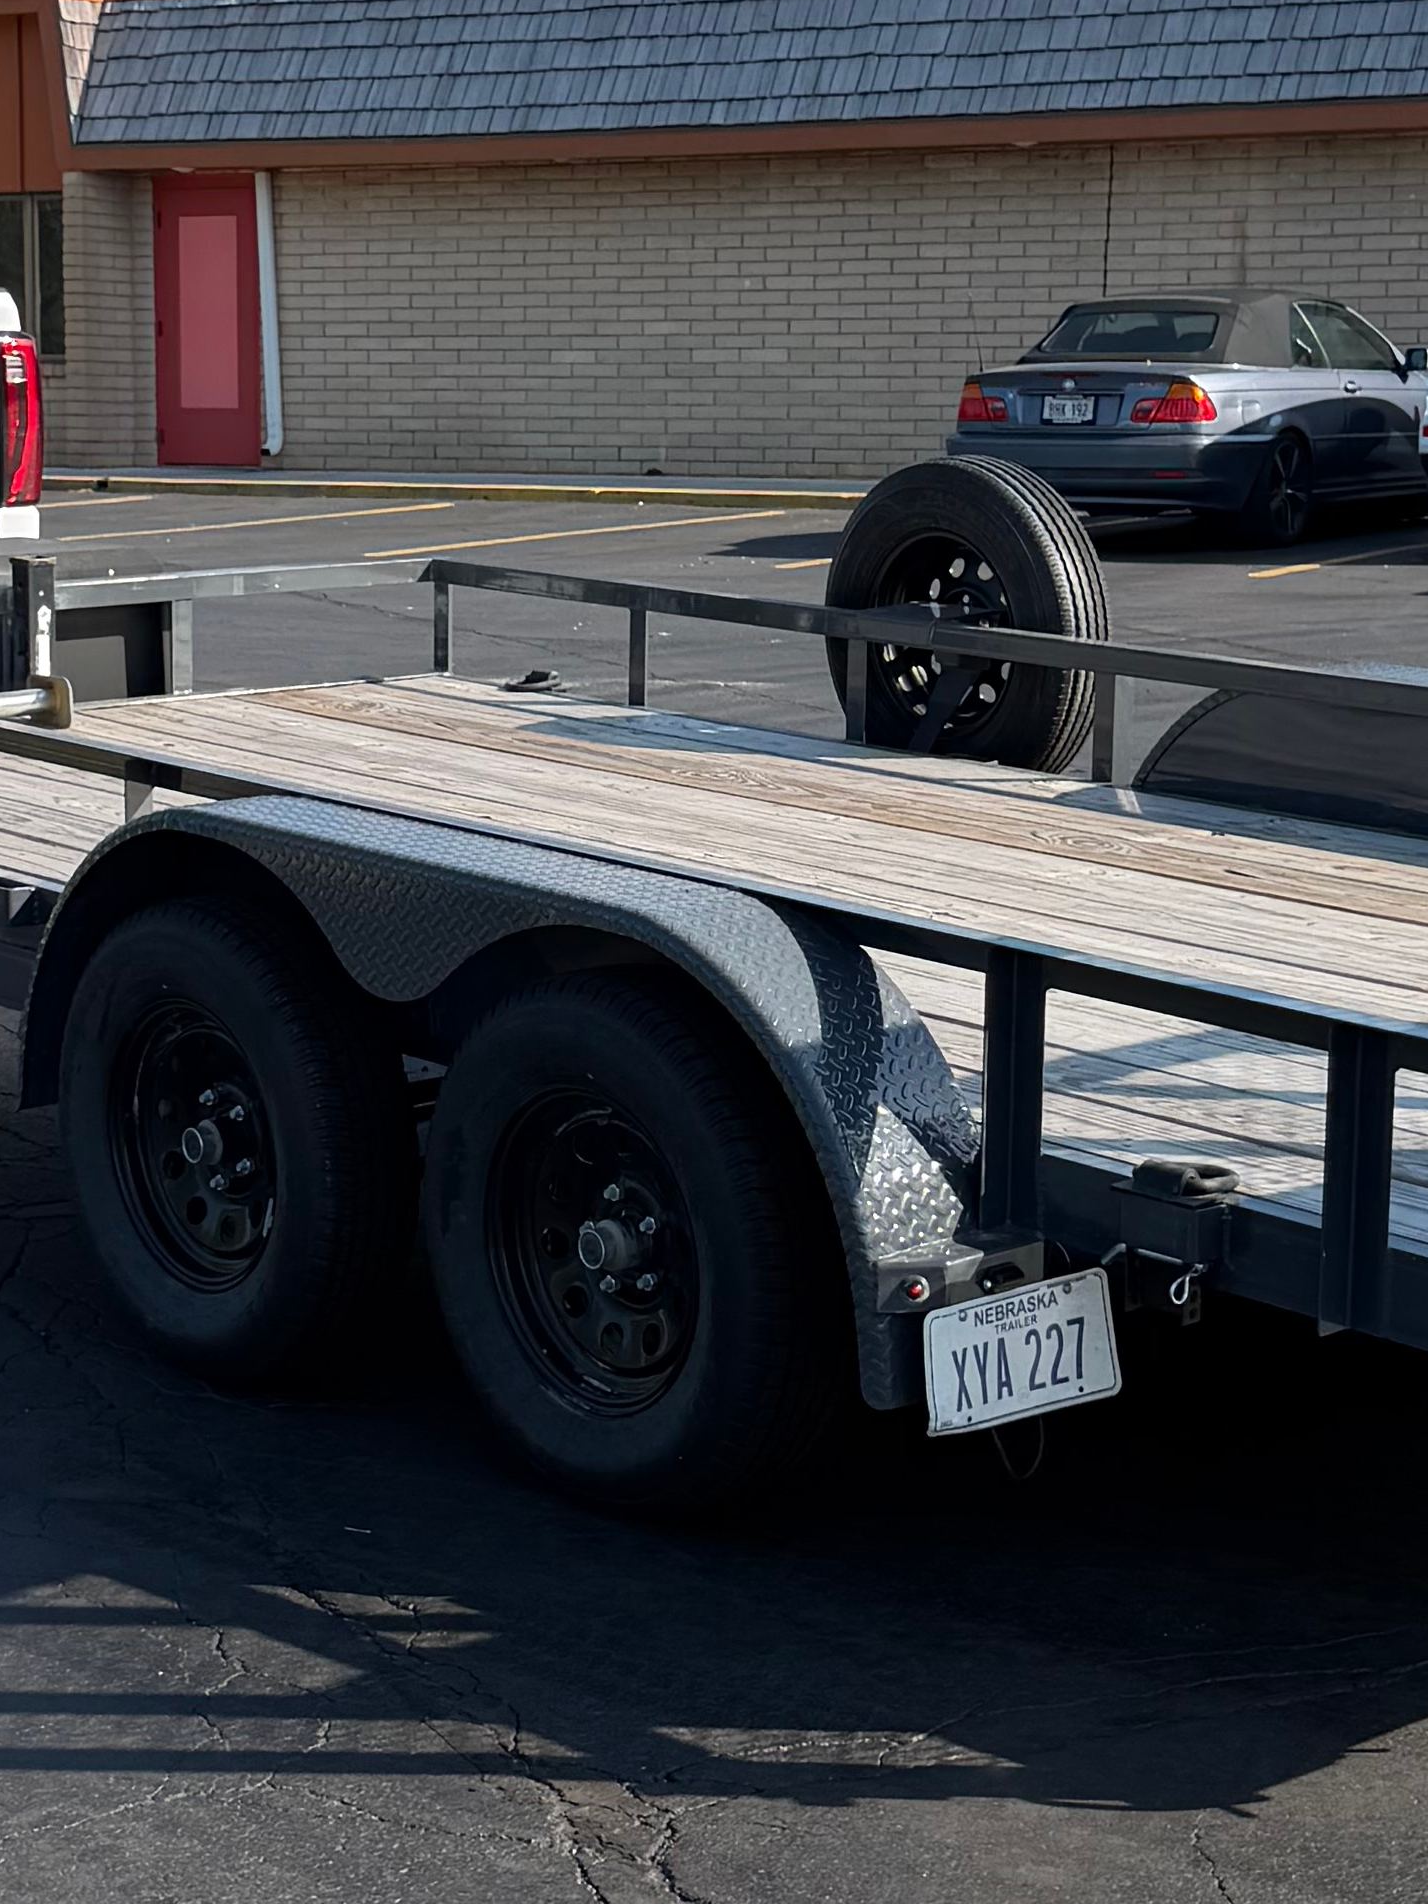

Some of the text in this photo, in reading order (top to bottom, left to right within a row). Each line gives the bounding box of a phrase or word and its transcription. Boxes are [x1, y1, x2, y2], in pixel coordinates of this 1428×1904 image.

[974, 1290, 1058, 1327] NEBRASKA
[995, 1314, 1038, 1335] TRAILER
[952, 1316, 1085, 1412] XYA 227
